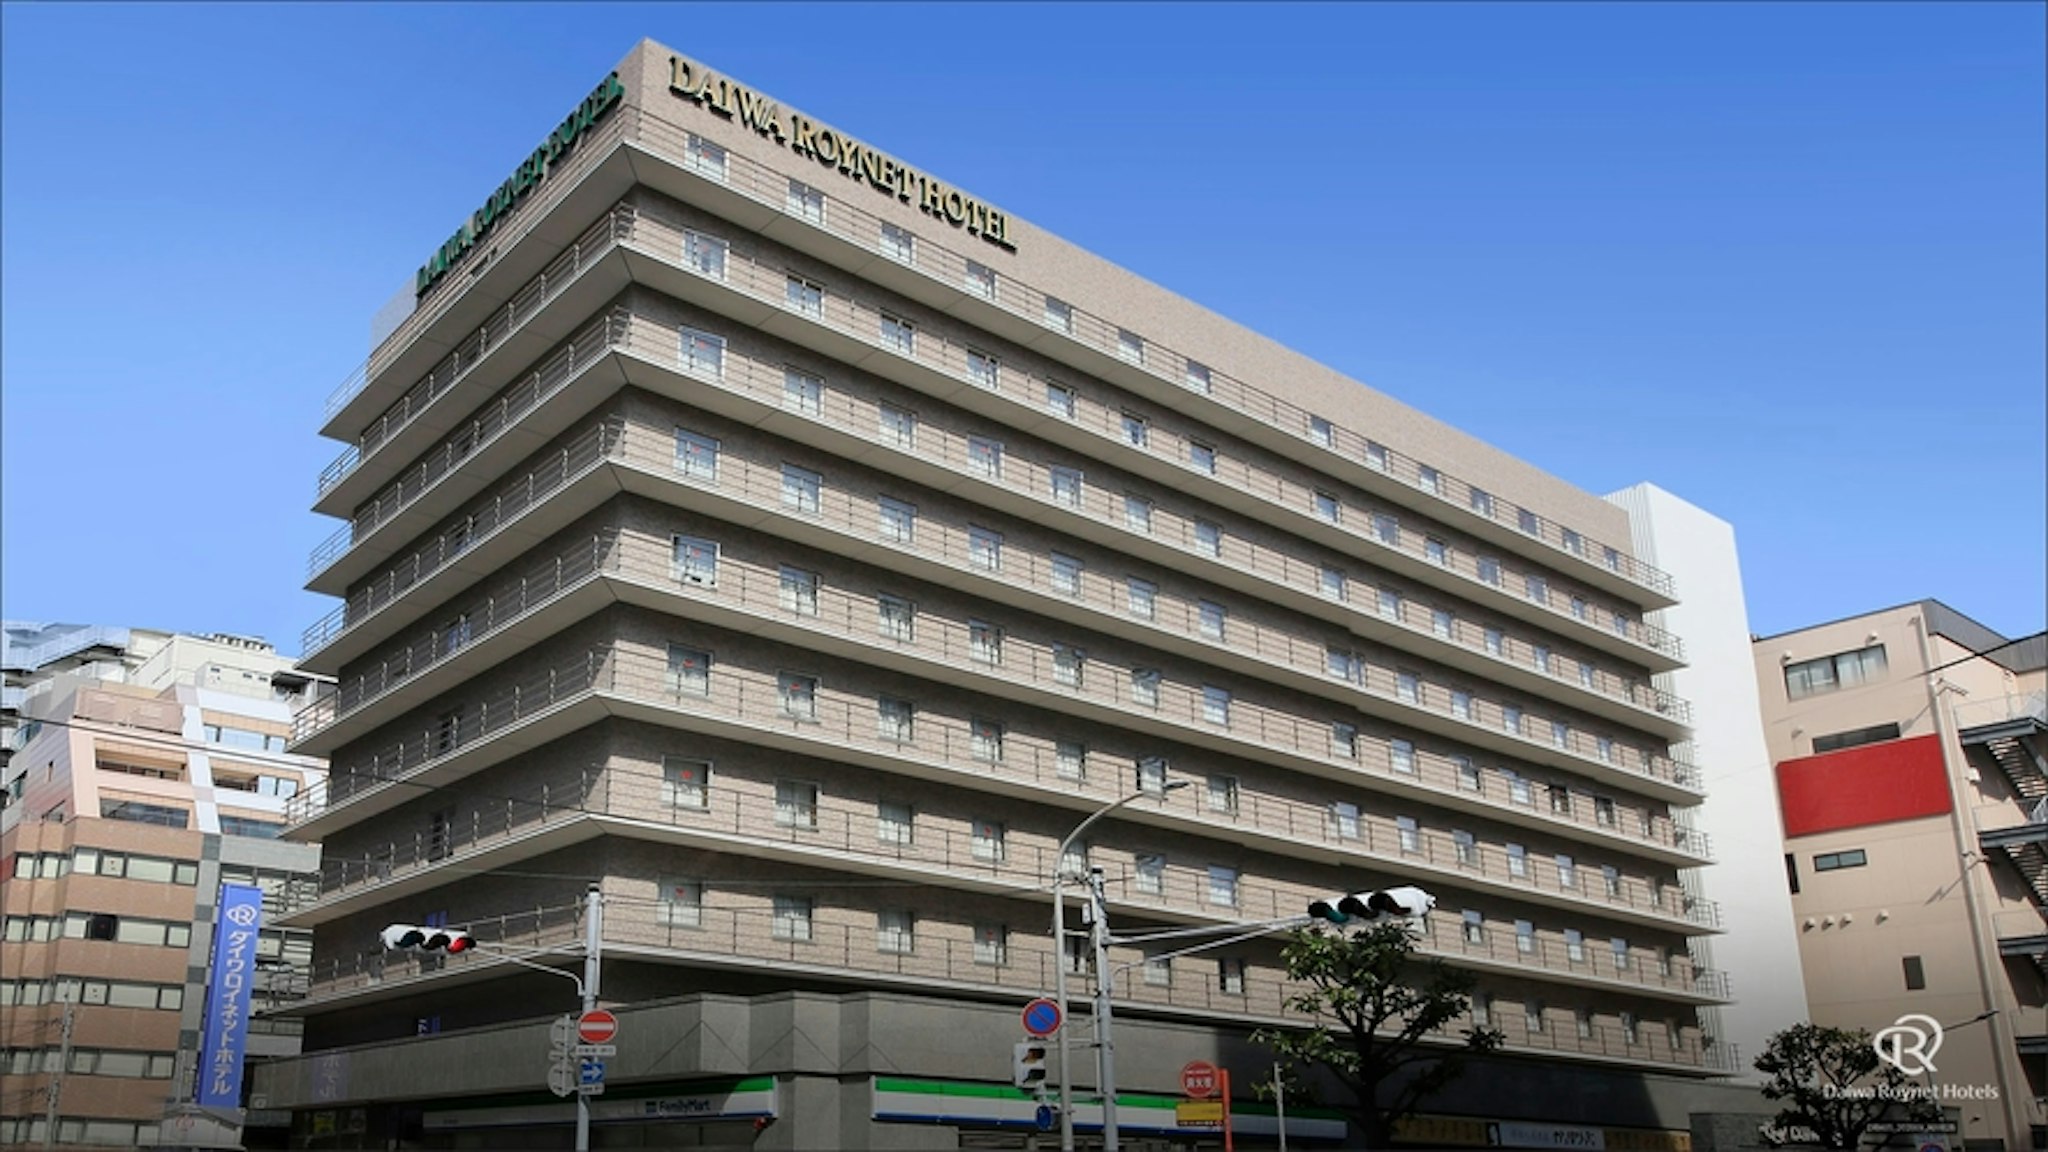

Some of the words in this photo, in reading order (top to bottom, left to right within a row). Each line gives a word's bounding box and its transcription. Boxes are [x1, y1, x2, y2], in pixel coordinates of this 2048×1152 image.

[668, 55, 787, 145] DAIWA
[789, 114, 917, 203] ROYNET
[918, 176, 1017, 254] HOTEL
[210, 930, 252, 1096] ダイワロイネットホテル
[659, 1099, 711, 1115] FamilyMart
